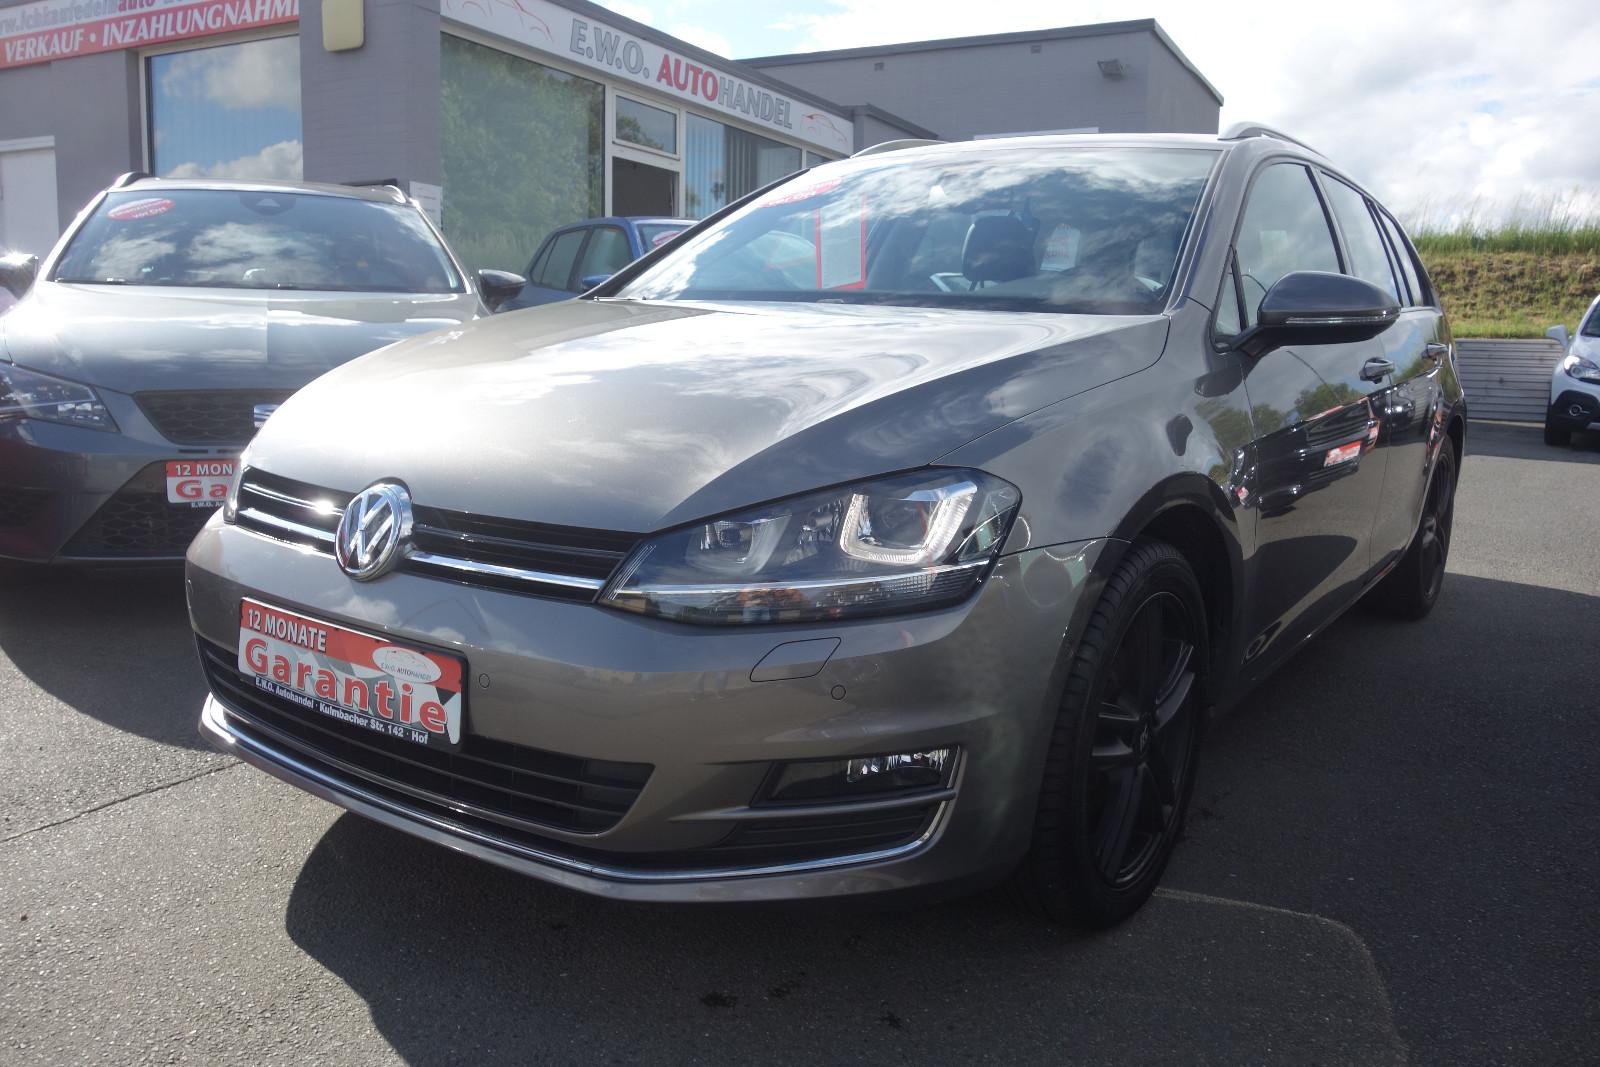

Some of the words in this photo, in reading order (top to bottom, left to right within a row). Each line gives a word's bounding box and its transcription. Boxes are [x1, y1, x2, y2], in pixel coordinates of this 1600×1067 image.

[4, 28, 84, 63] VERKAUF
[569, 18, 650, 79] E.W.O.
[656, 54, 793, 129] AUTOHANDEL
[175, 464, 191, 476] 12
[196, 463, 233, 476] MON
[247, 608, 262, 631] 12
[264, 612, 327, 653] MONATE
[244, 638, 447, 734] Garantie
[255, 676, 275, 694] E.W.O.
[275, 686, 314, 709] Autohandel
[319, 703, 368, 727] Kulmbacher
[370, 718, 385, 732] Str.
[387, 724, 404, 738] 142
[411, 731, 429, 745] Hof
